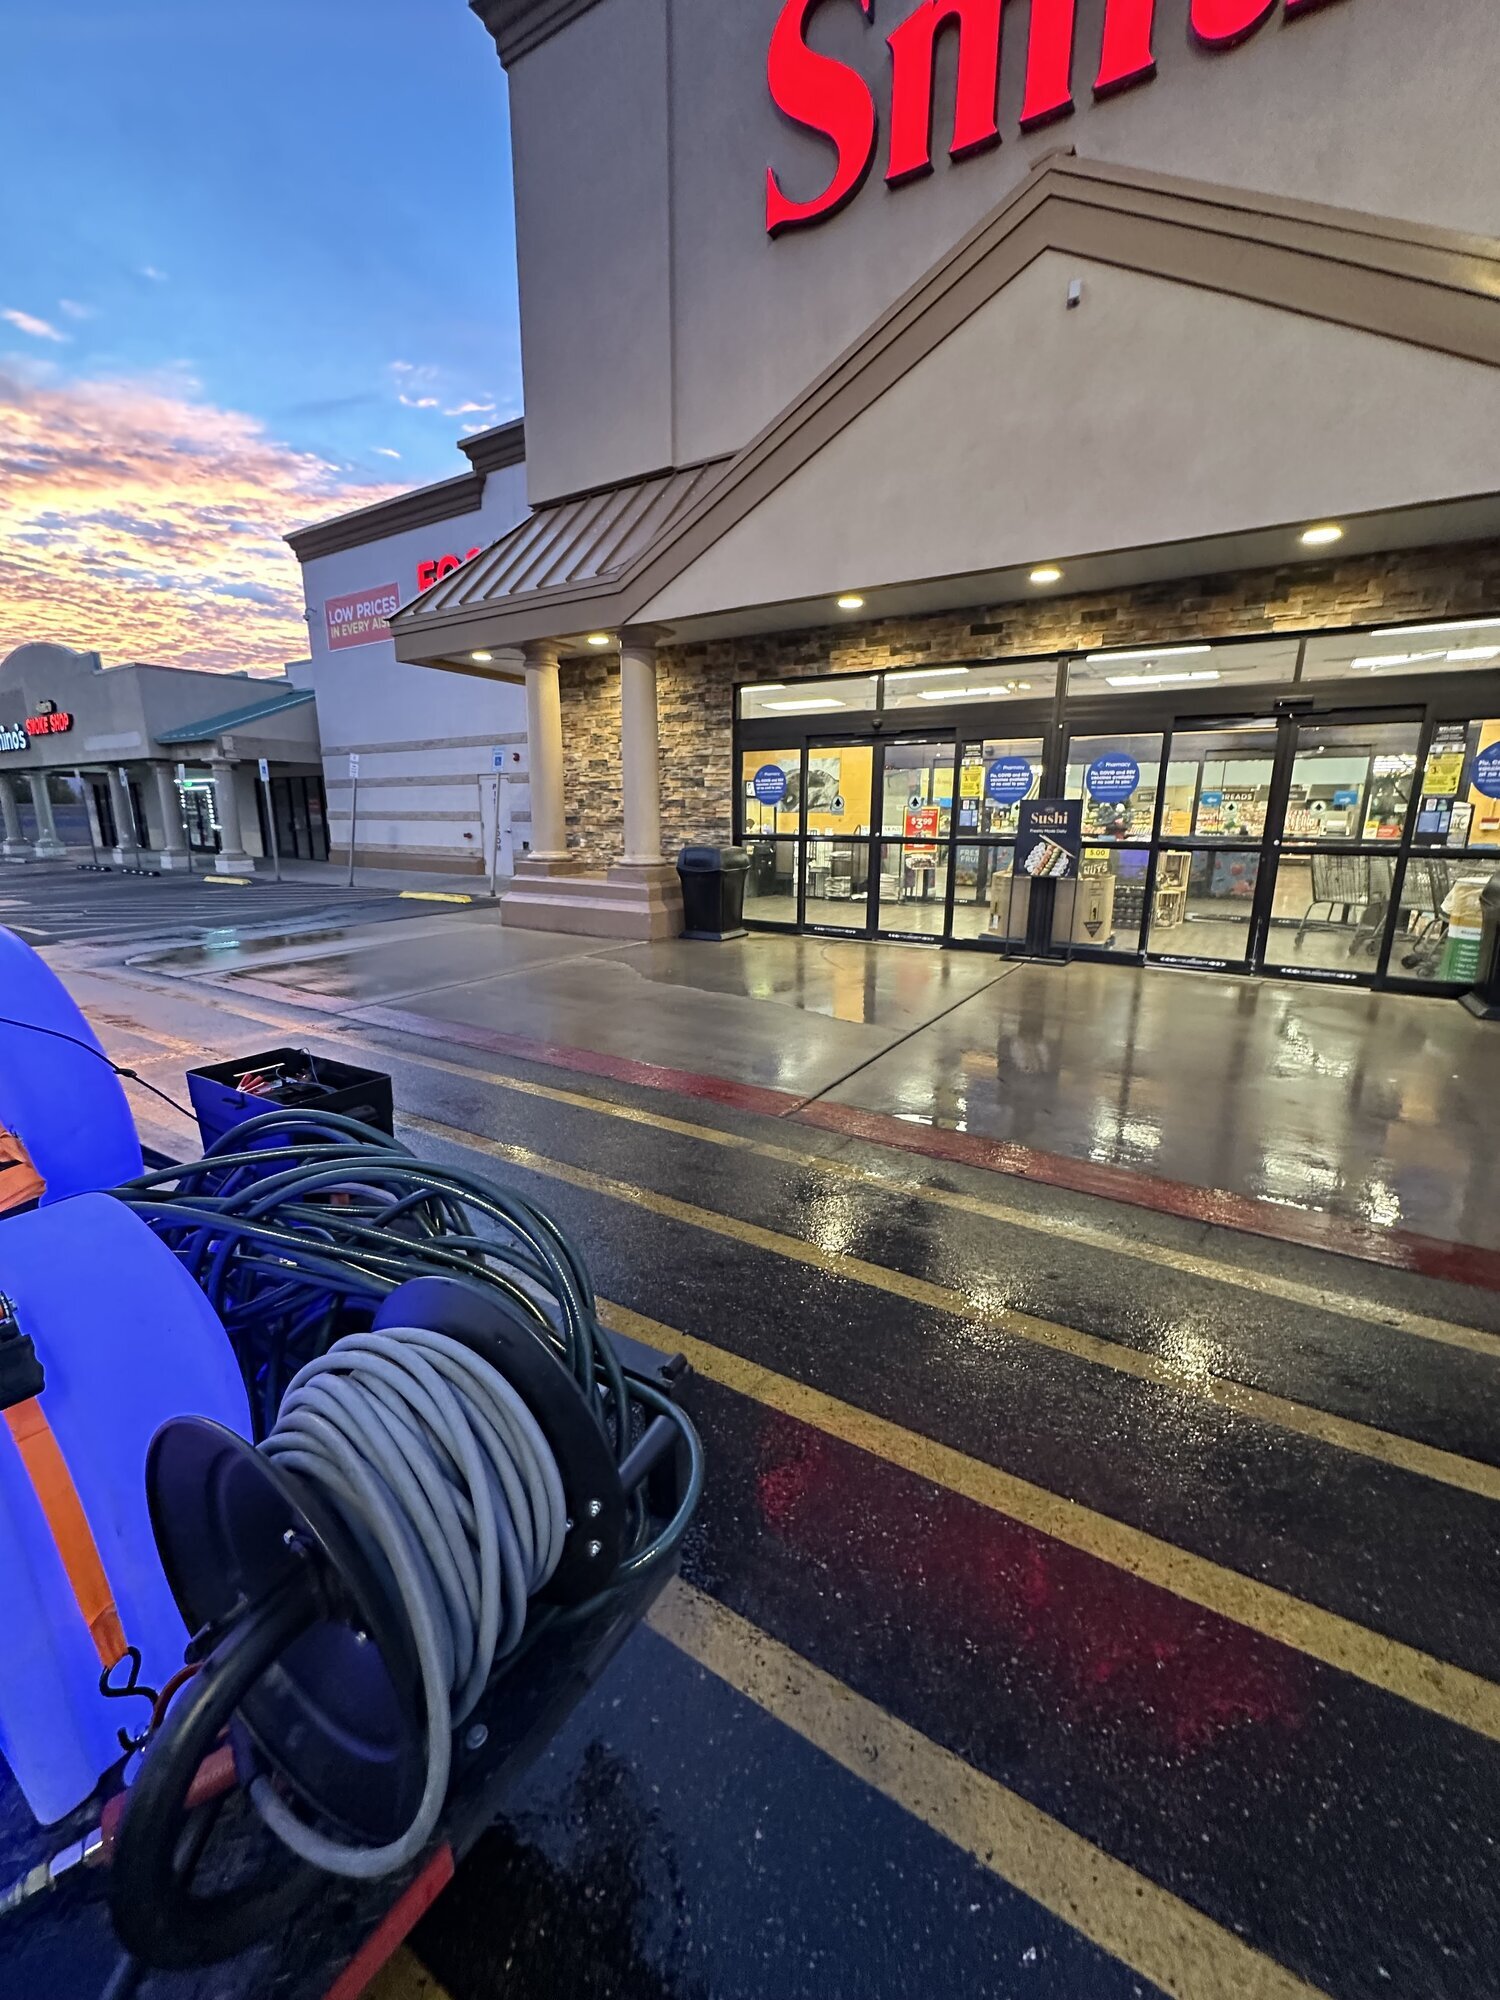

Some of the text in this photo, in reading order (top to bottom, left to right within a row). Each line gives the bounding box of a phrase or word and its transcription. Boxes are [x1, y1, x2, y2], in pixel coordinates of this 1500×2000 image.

[328, 596, 397, 625] LOW PRICES
[330, 626, 340, 639] IN
[341, 619, 369, 636] EVERY
[26, 712, 69, 735] SMOKE SHOP
[1030, 811, 1068, 824] Sushi
[1084, 862, 1107, 875] NUTS
